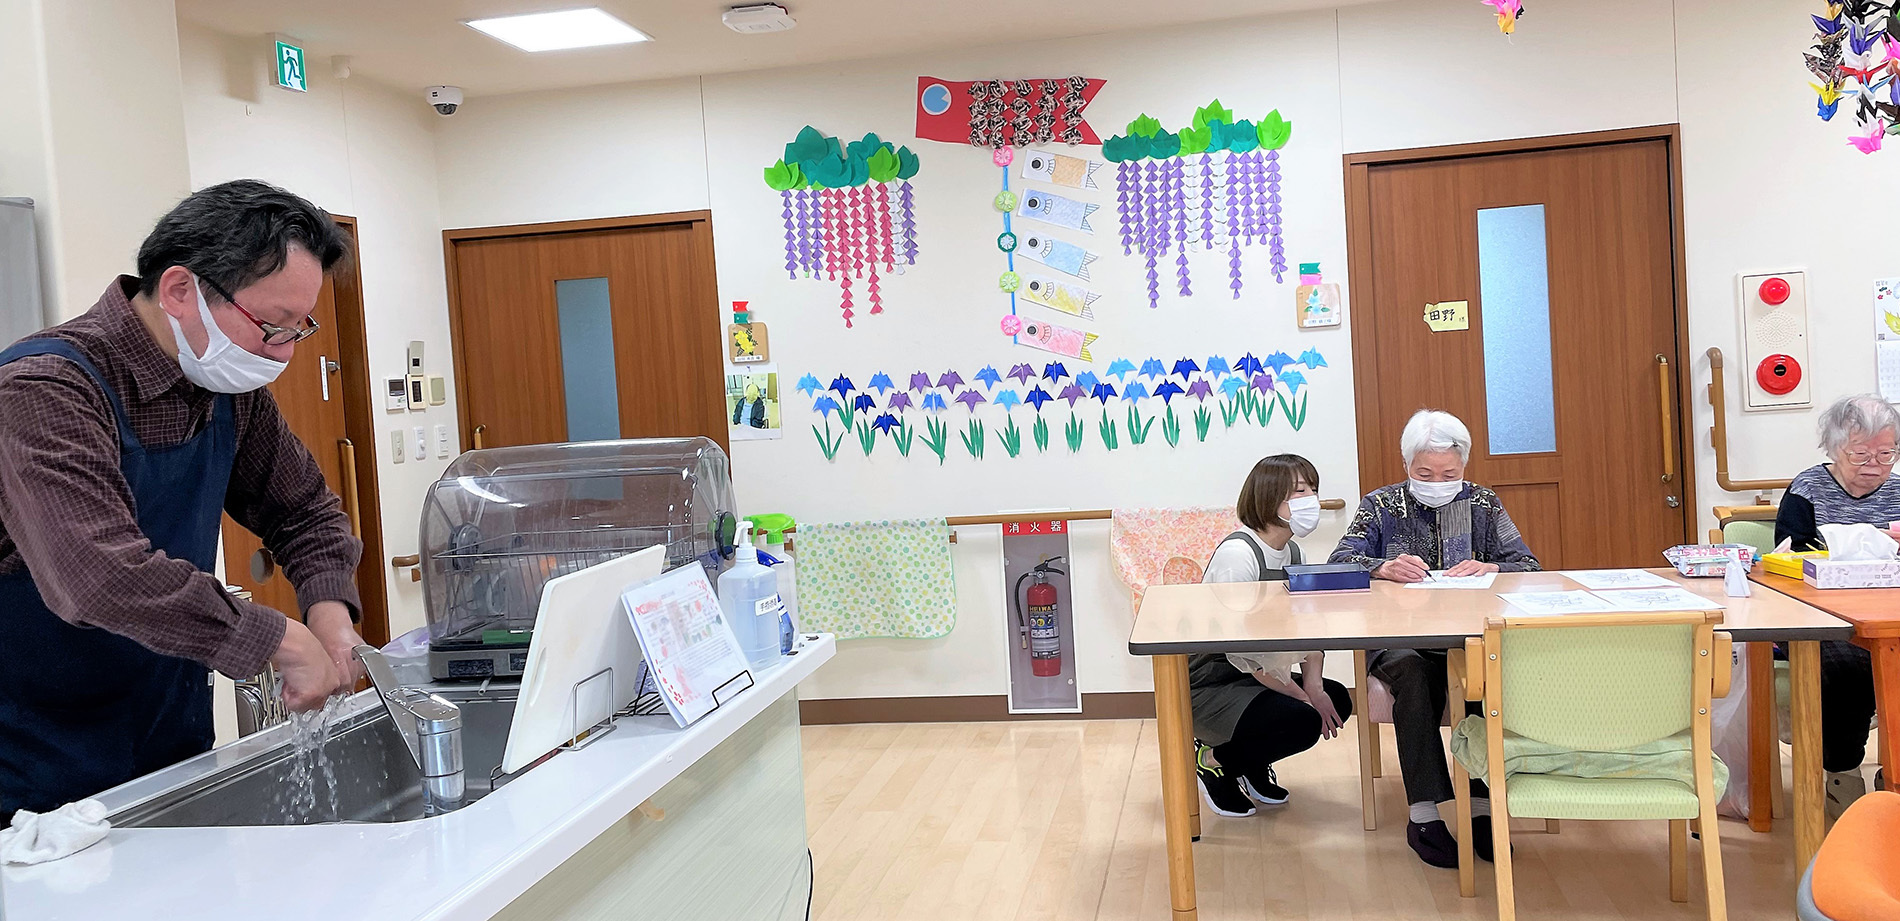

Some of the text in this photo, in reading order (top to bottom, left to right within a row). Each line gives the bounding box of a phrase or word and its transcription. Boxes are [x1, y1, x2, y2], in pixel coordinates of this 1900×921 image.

[1430, 309, 1455, 321] 田野
[1009, 520, 1061, 533] 消火器
